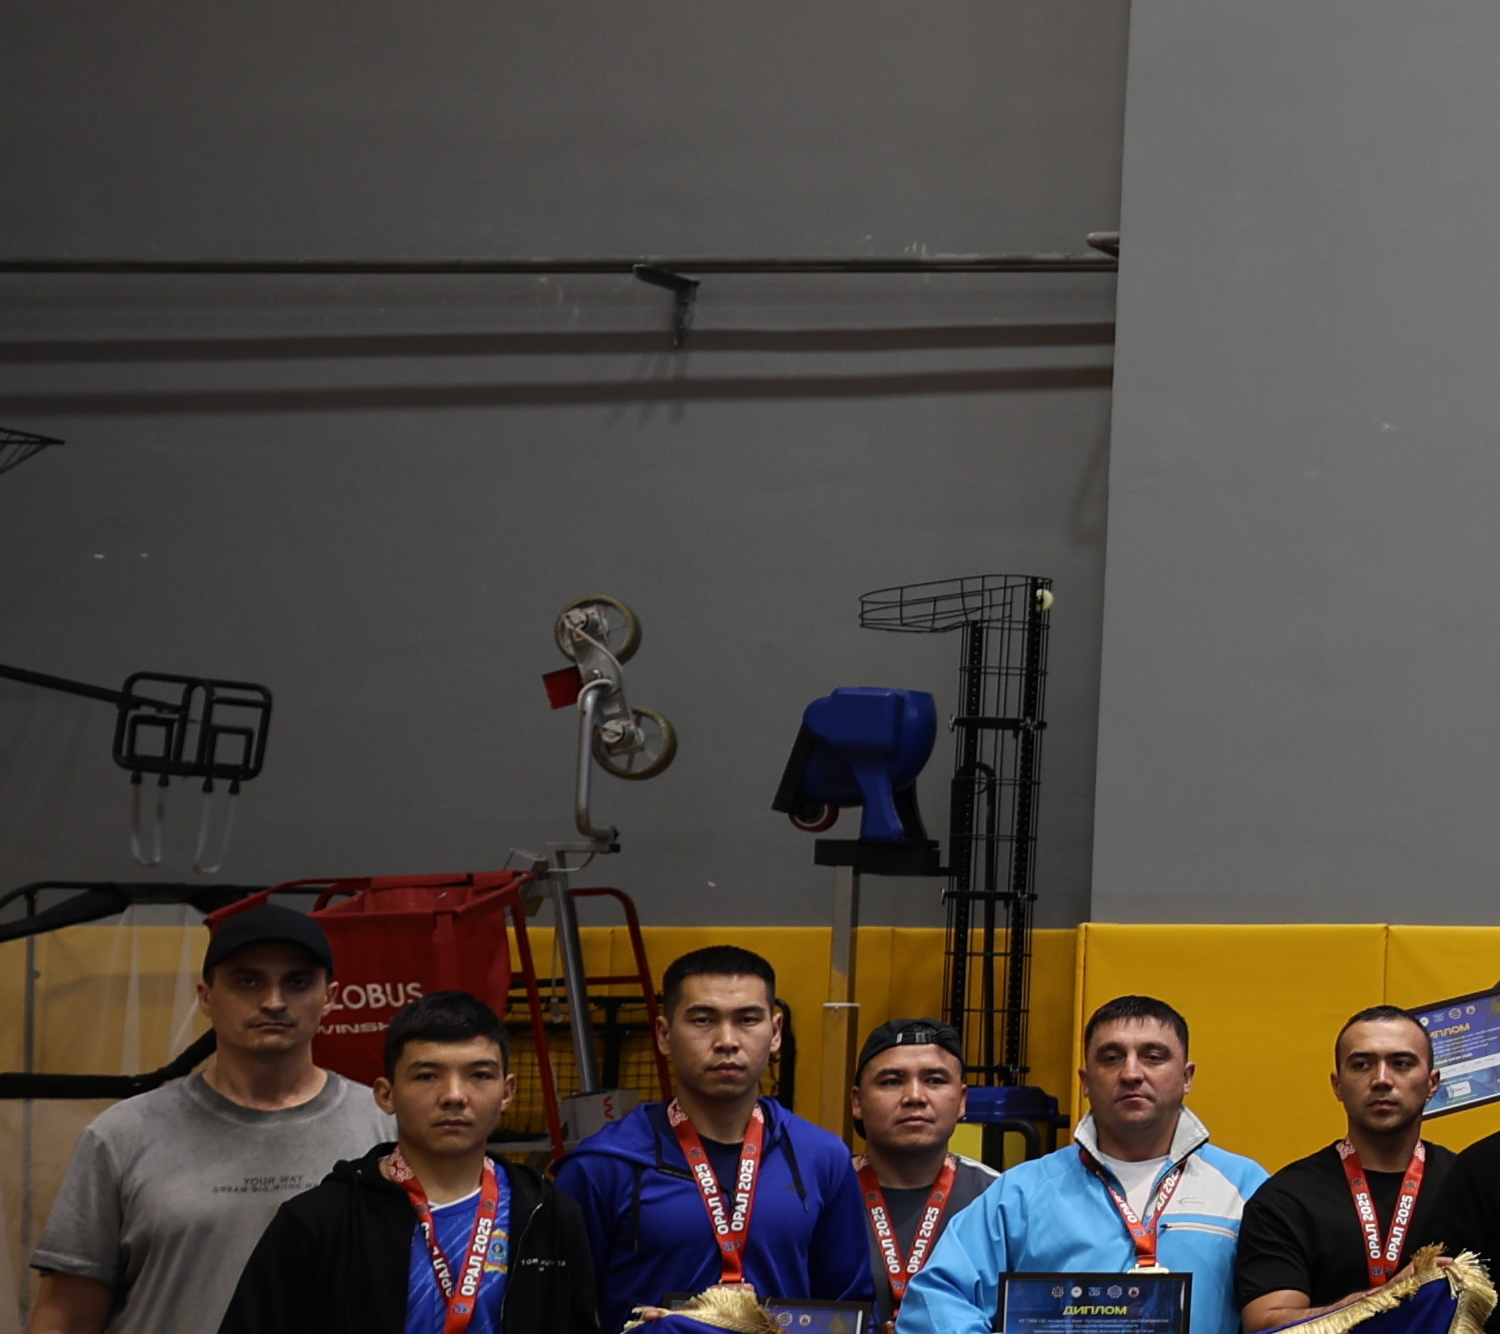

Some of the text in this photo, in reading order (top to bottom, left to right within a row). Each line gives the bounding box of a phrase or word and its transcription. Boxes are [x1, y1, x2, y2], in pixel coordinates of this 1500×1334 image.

[1428, 1022, 1471, 1038] ИПЛОМ
[694, 1163, 730, 1235] ОРАЛ 2025
[731, 1158, 755, 1232] ОРАЛ 2025
[1355, 1191, 1382, 1260] ОРАЛ 2025
[1386, 1195, 1415, 1262] ОРАЛ 2025
[461, 1217, 493, 1297] ОРАЛ 2025
[870, 1206, 901, 1274] ОРАЛ 2025
[906, 1206, 940, 1274] ОРАЛ 2025
[1062, 1305, 1128, 1316] ДИПЛОМ
